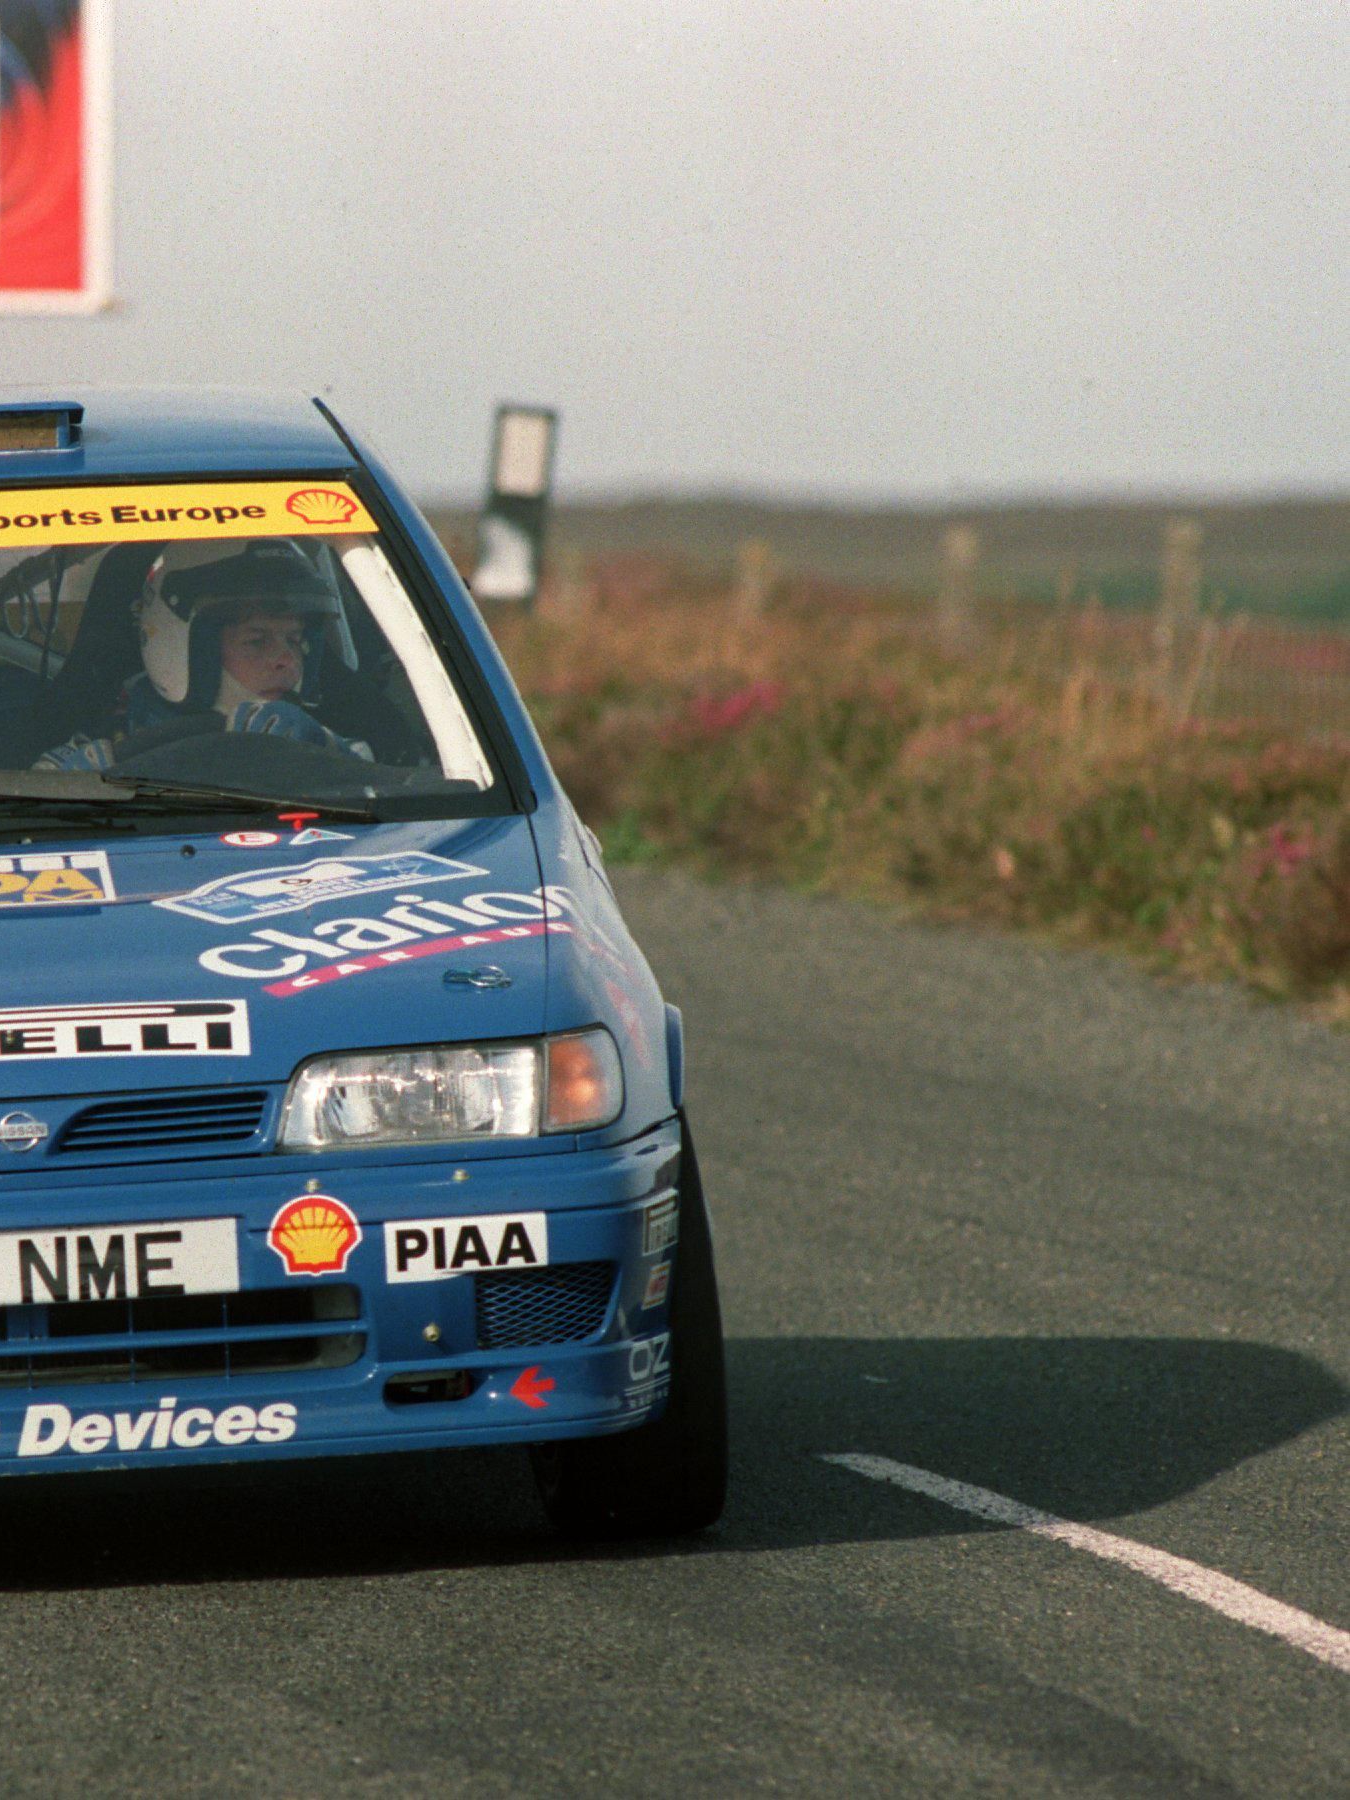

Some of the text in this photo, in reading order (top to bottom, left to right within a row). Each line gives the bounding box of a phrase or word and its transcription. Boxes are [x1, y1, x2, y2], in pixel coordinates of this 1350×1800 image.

[110, 499, 267, 527] Europe
[291, 948, 415, 988] CAR
[18, 1230, 186, 1303] NME
[394, 1221, 539, 1273] PIAA
[17, 1396, 298, 1458] Devices
